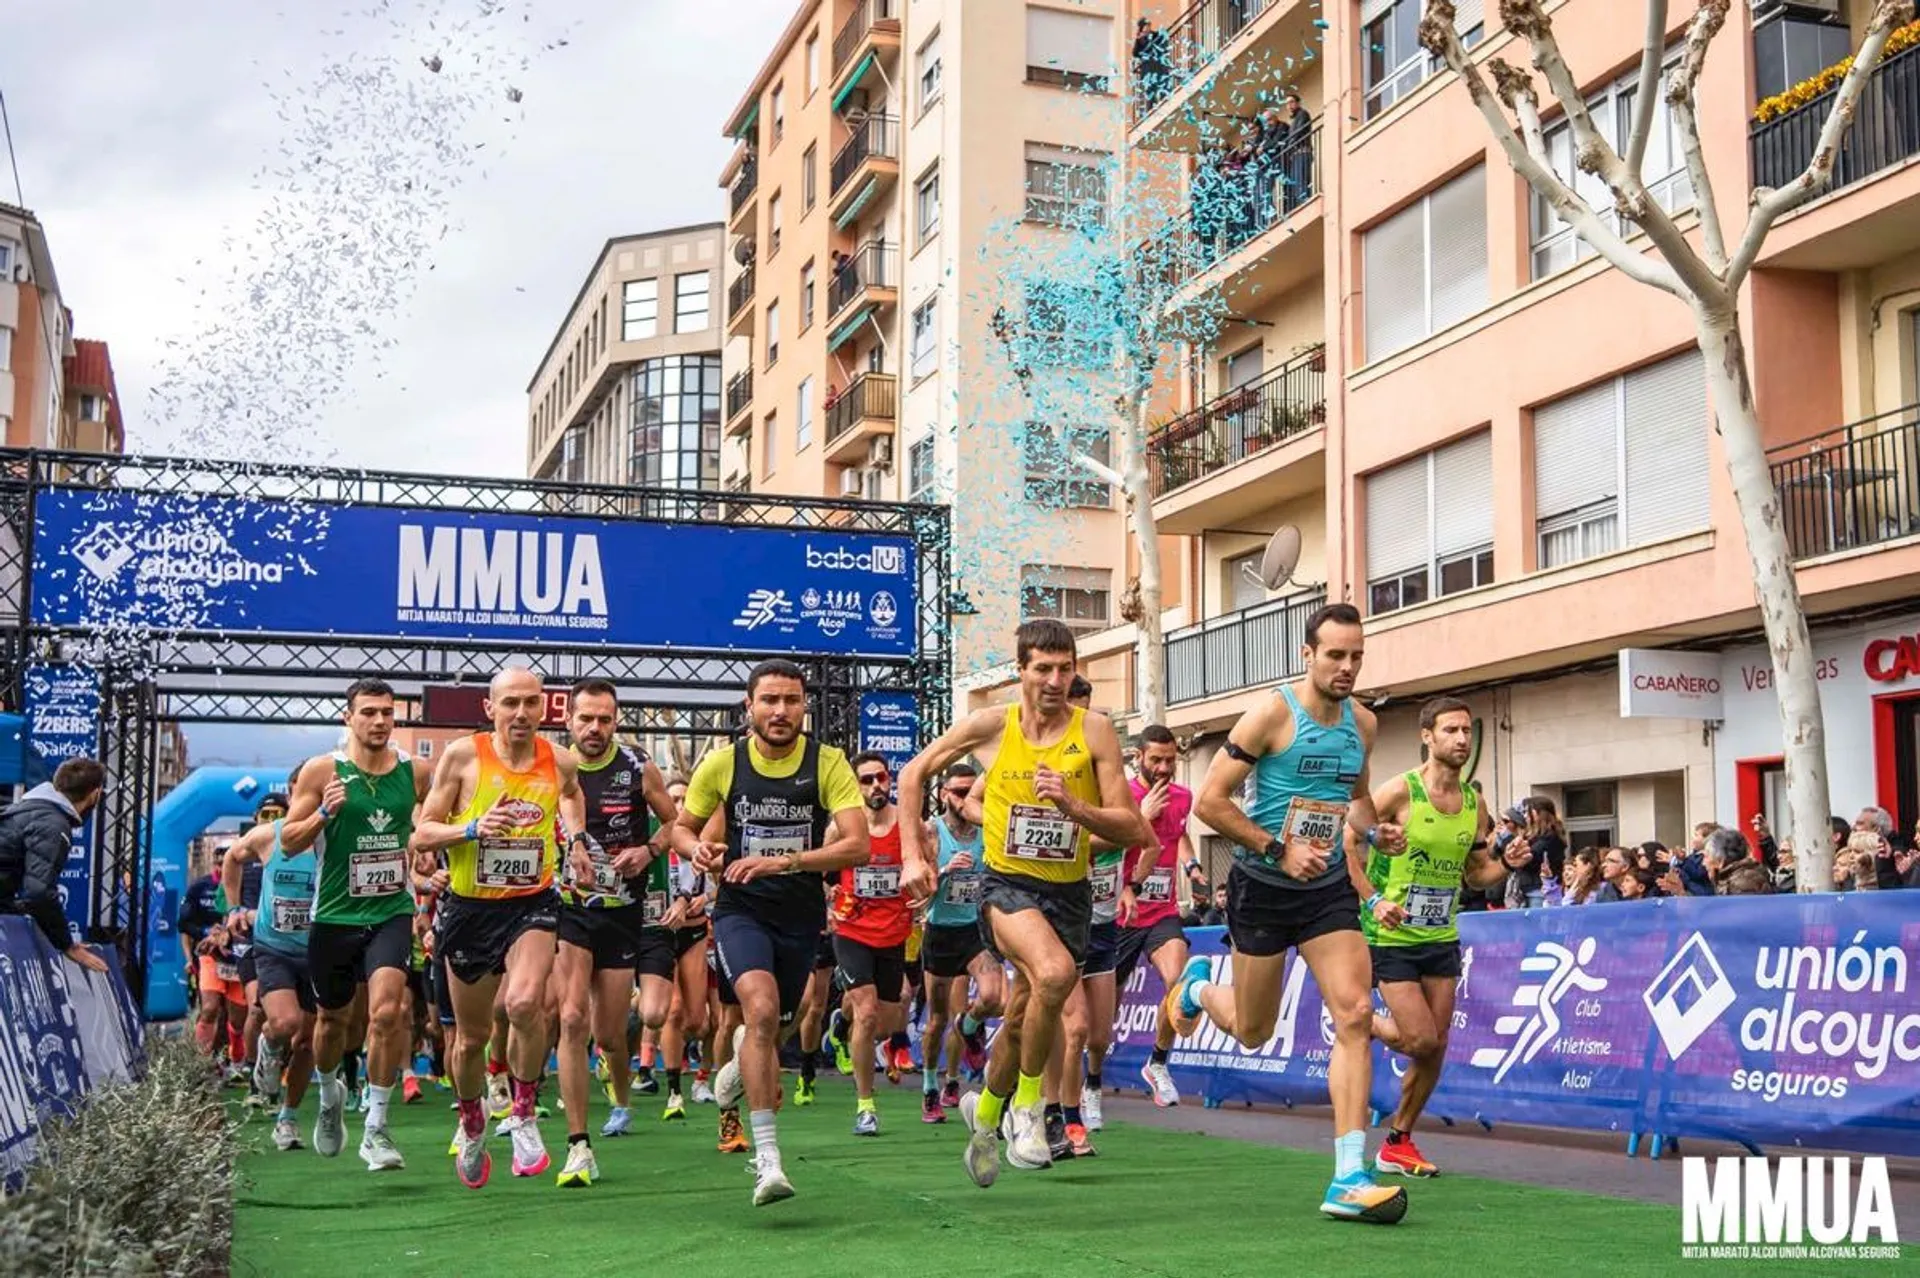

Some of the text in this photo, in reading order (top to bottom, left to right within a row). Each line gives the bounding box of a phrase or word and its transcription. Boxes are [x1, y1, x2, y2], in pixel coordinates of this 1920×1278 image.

[398, 525, 608, 615] MMUA
[397, 609, 608, 630] MITJA MARATÓ ALCOI UNIÓN ALCOYANA SEGUROS
[817, 617, 846, 629] Alcoi
[1634, 673, 1720, 693] CABAÑERO
[32, 716, 91, 734] 226ERS
[867, 735, 912, 752] 226ERS
[735, 802, 787, 819] ALEJANDRO
[1025, 828, 1063, 847] 2234
[1299, 820, 1334, 839] 3005
[493, 858, 530, 875] 2280
[366, 869, 395, 885] 2278
[1144, 881, 1164, 893] 2311
[1420, 903, 1445, 917] 1235
[1755, 929, 1908, 993] unión
[1574, 999, 1602, 1017] Club
[1551, 1036, 1612, 1055] Atletisme
[1561, 1069, 1593, 1089] Alcoi
[1731, 1068, 1848, 1102] seguros
